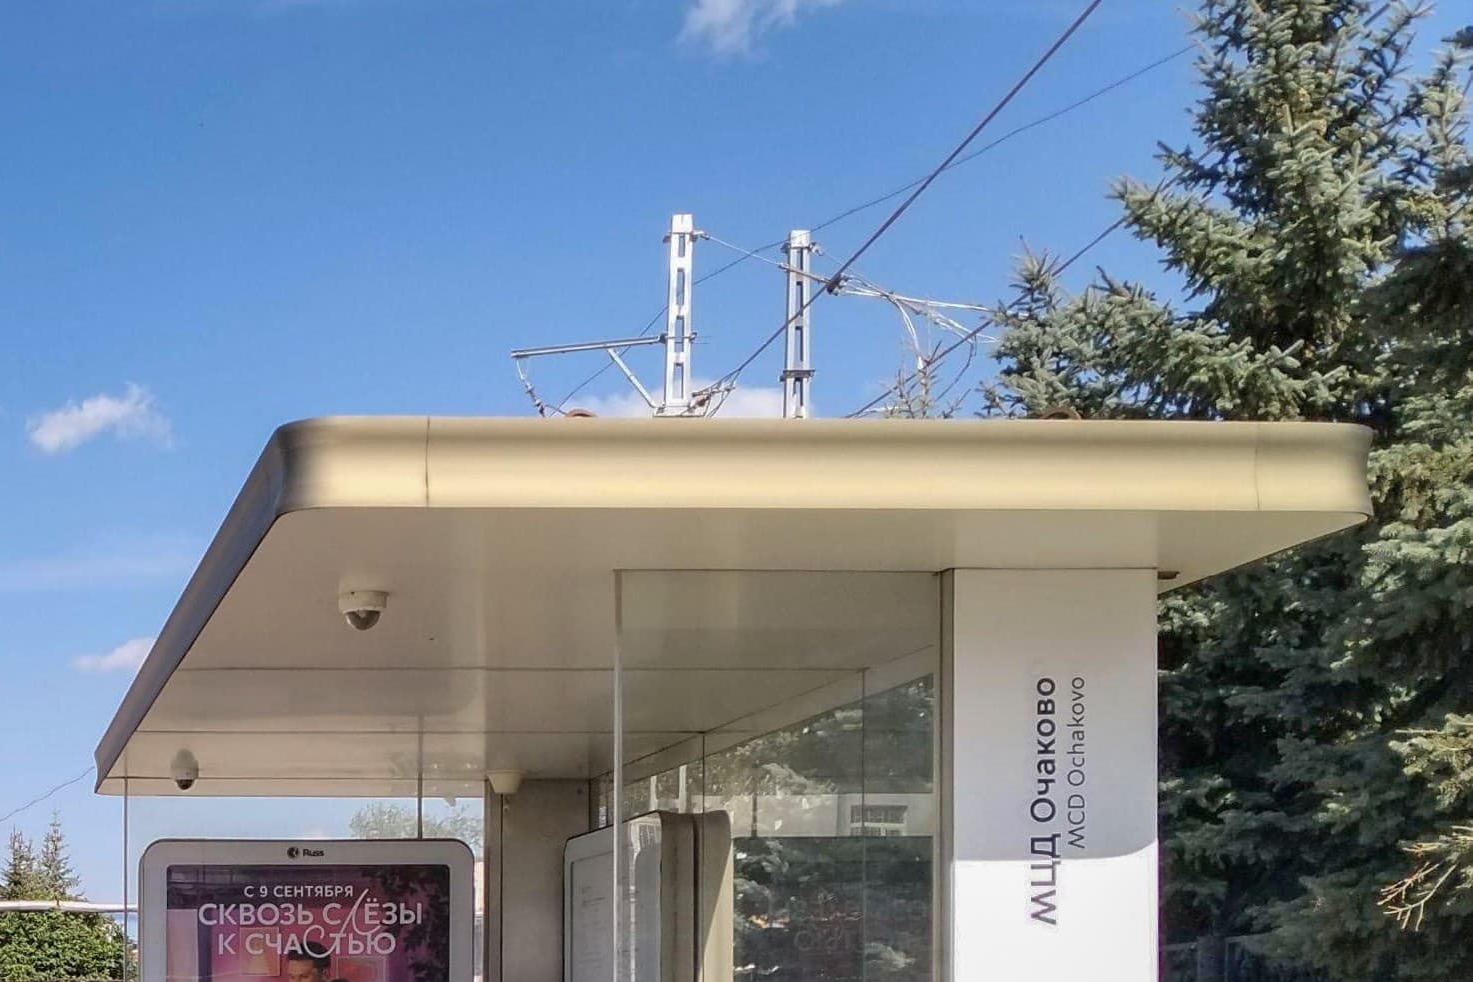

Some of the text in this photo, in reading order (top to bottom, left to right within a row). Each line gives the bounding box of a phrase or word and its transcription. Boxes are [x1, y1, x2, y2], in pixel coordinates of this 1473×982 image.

[1066, 675, 1086, 849] MCD Ochakovo
[1029, 676, 1061, 926] МЦД Очаково
[198, 889, 423, 935] СКВОЗЬ СЛЁЗЫ
[243, 885, 354, 898] С 9 СЕНТЯБРЯ
[218, 925, 397, 958] К СЧАСТЬЮ
